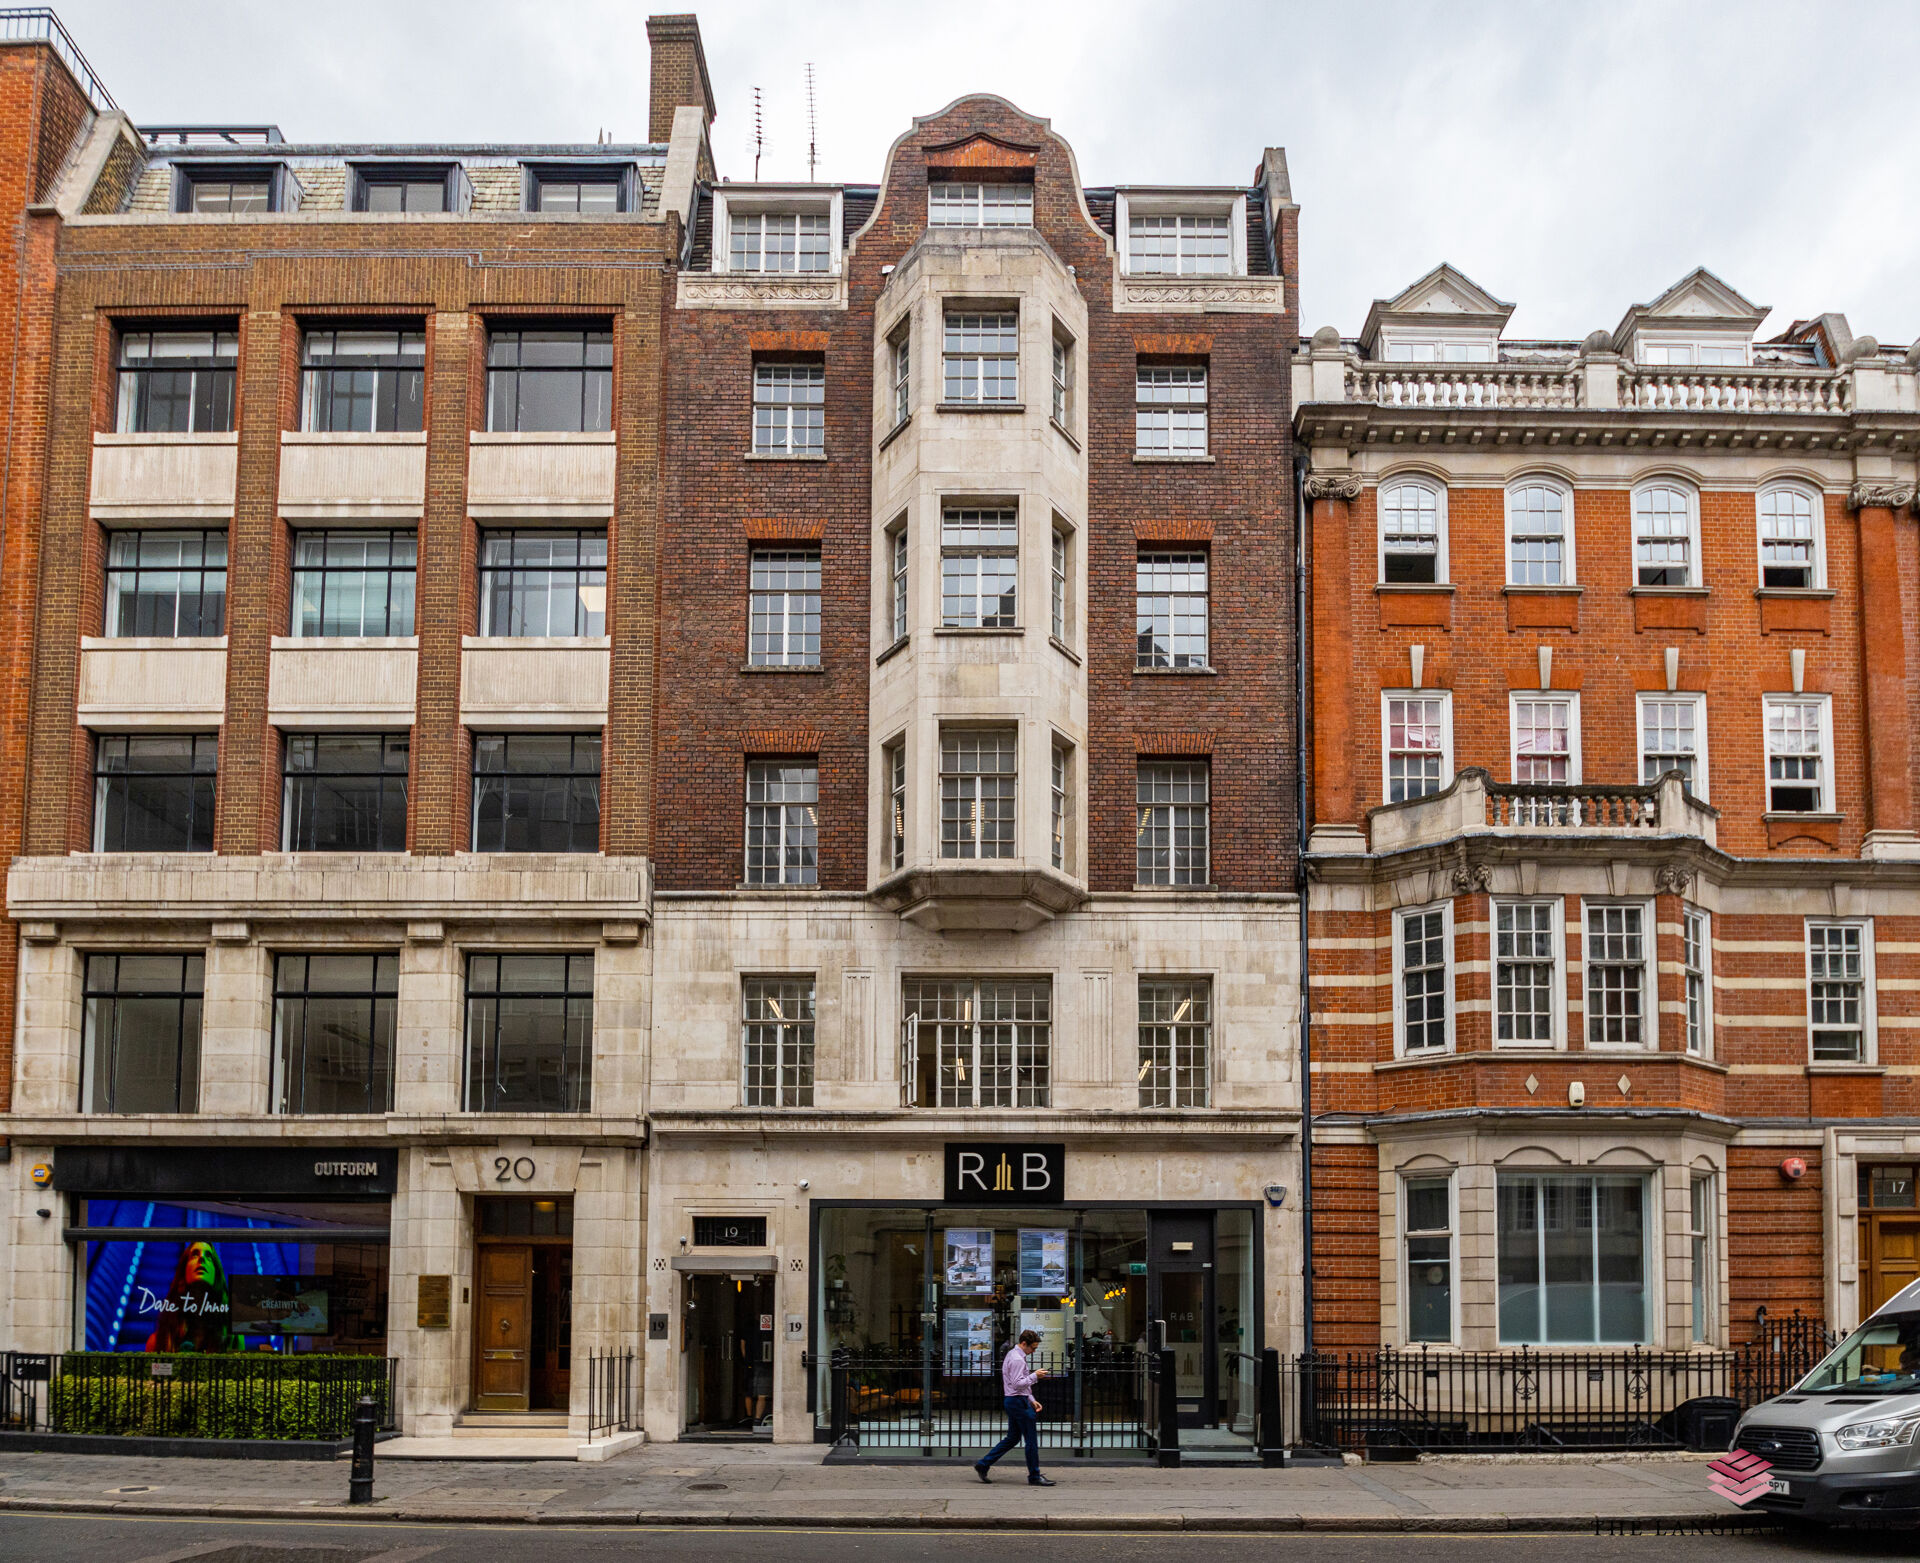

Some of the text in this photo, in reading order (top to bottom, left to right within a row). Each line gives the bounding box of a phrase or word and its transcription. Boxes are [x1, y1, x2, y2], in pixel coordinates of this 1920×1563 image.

[314, 1161, 379, 1177] OUTFORM
[494, 1156, 536, 1183] 20
[1892, 1181, 1906, 1194] 17
[725, 1226, 739, 1238] 19
[138, 1285, 179, 1314] Dare
[180, 1291, 197, 1313] to
[261, 1300, 299, 1309] CREATIVITY
[652, 1321, 665, 1332] 19
[789, 1321, 802, 1333] 19
